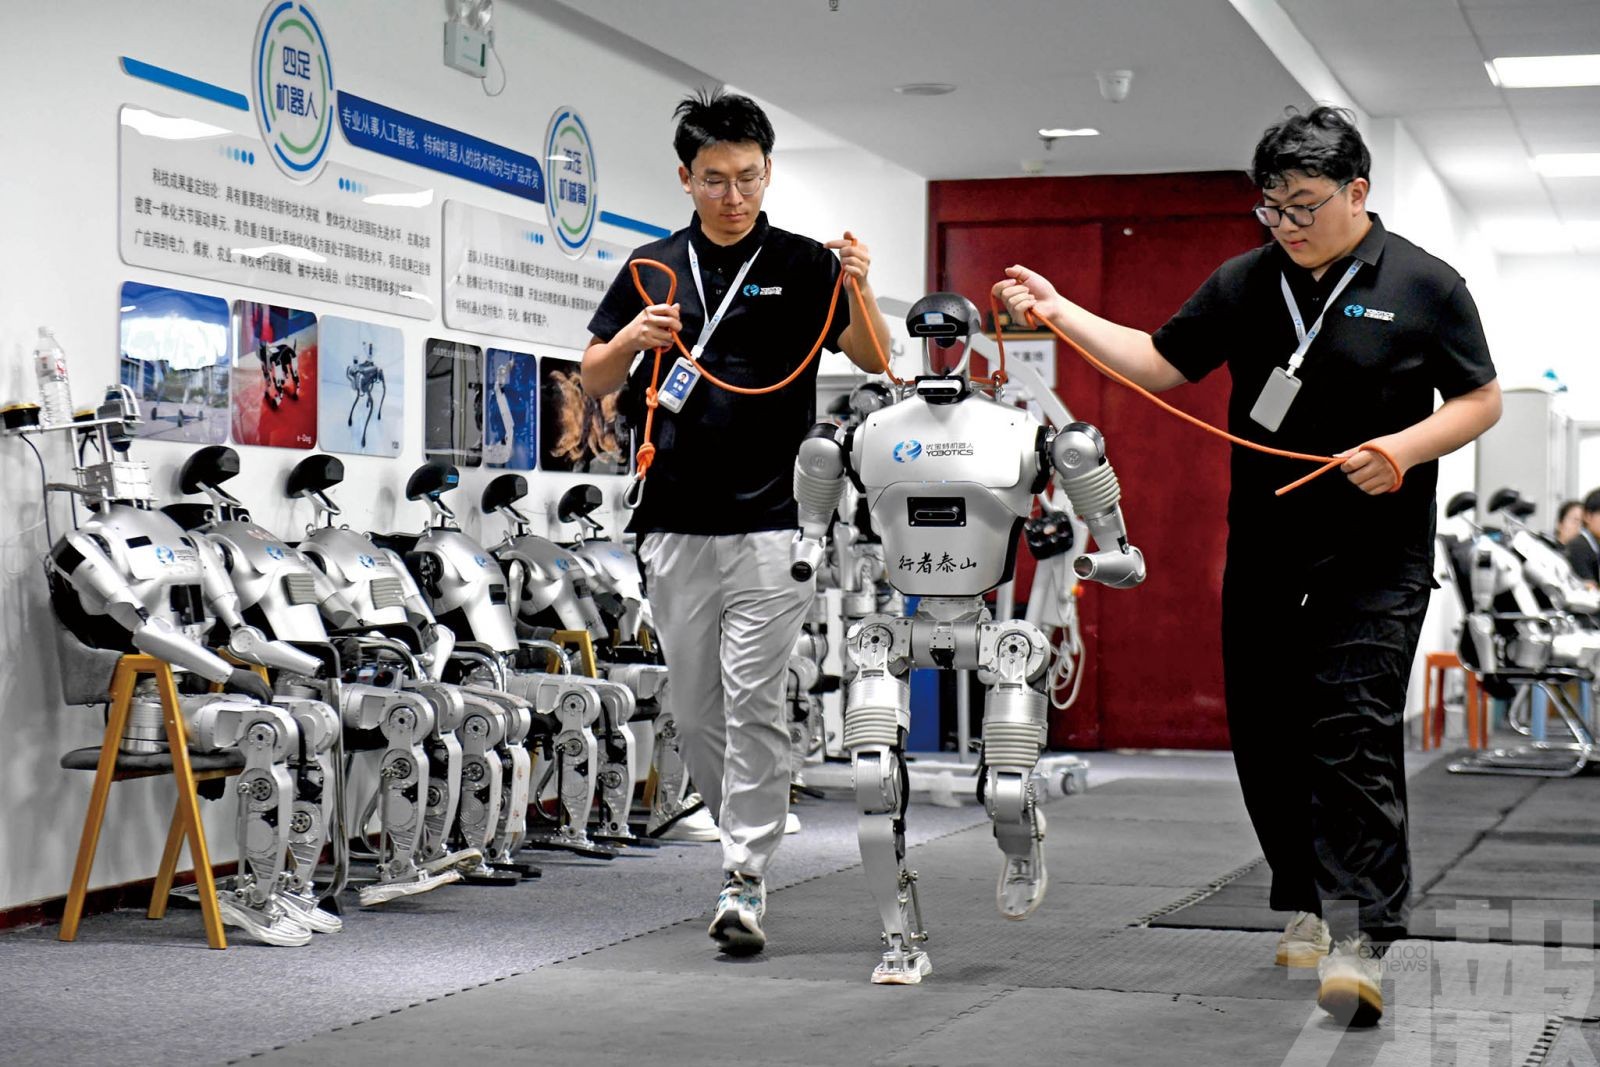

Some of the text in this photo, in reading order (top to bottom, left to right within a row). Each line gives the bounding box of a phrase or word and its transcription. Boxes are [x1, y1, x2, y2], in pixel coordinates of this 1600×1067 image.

[282, 46, 311, 80] 四足
[276, 83, 318, 119] 机器人
[342, 107, 540, 190] 专业从事人工智能、特种机器人的技术研究与产品开发
[926, 449, 974, 457] YOBOTICS
[898, 551, 977, 574] 行者泰山
